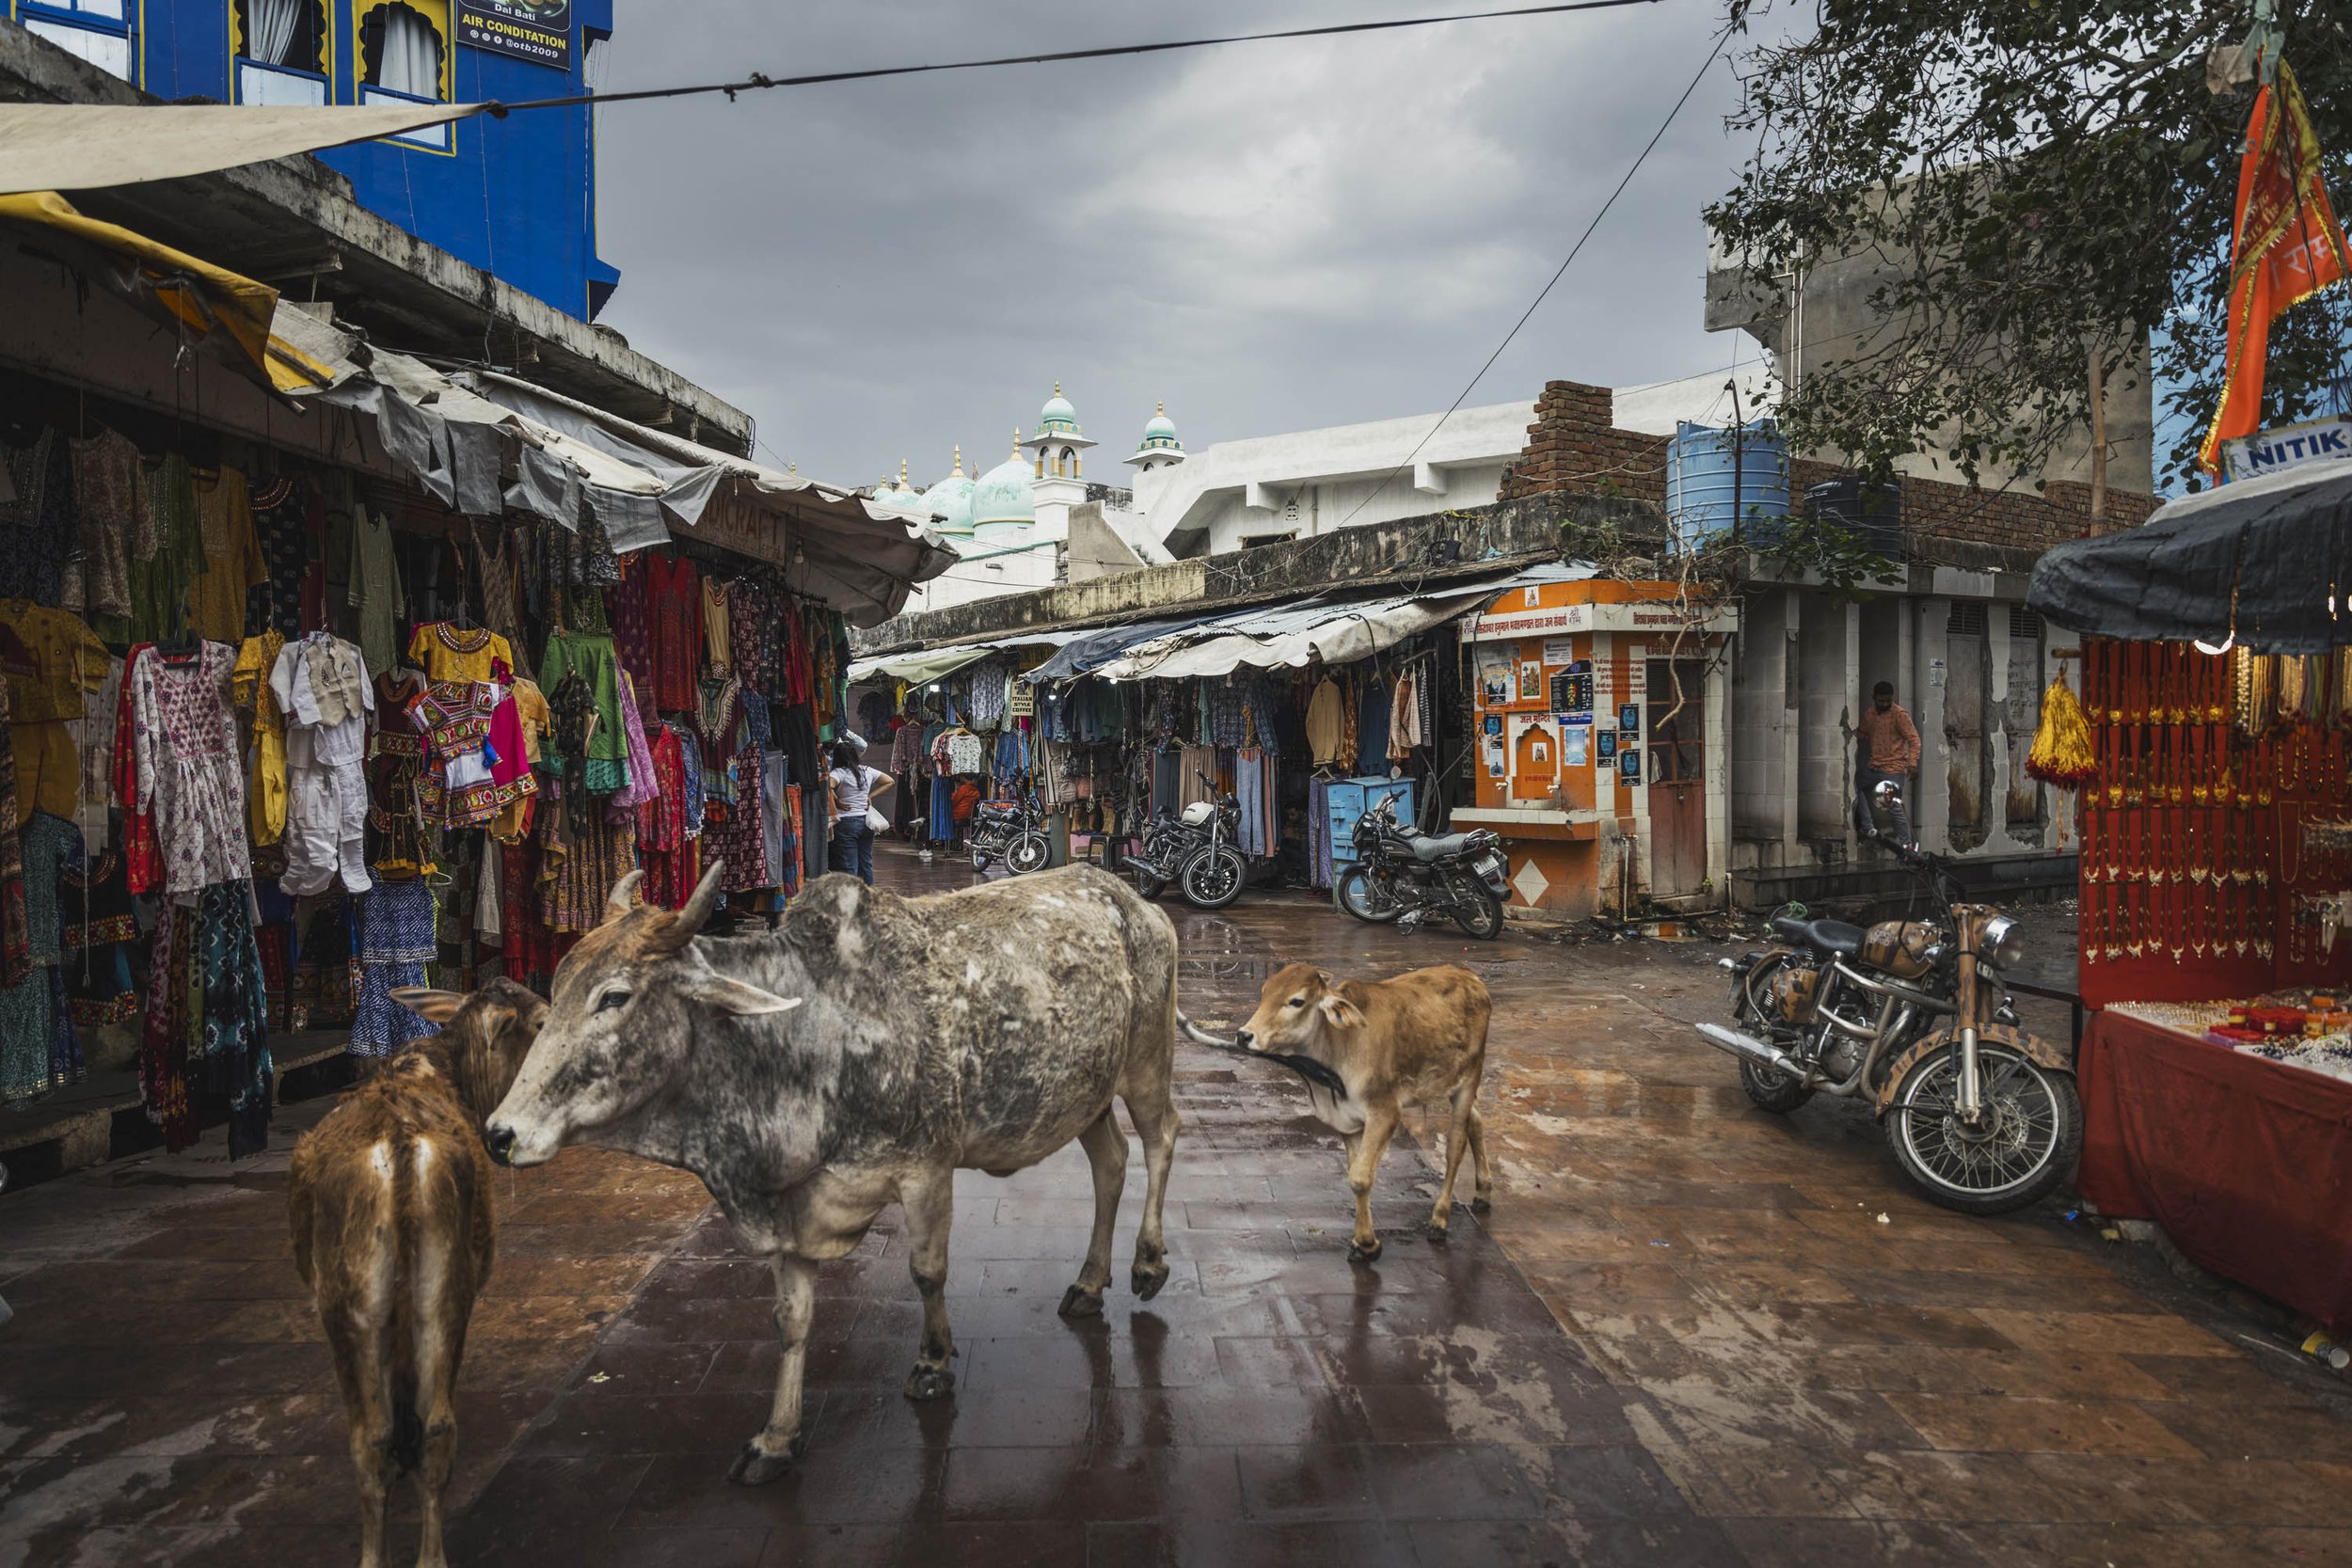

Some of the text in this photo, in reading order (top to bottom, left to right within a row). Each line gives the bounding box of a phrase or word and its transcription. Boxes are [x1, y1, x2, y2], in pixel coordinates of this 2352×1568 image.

[494, 4, 536, 22] Dal Bati
[462, 14, 566, 50] AIR CONDITATION
[505, 39, 559, 58] @otb2009
[2249, 429, 2347, 468] NITIK
